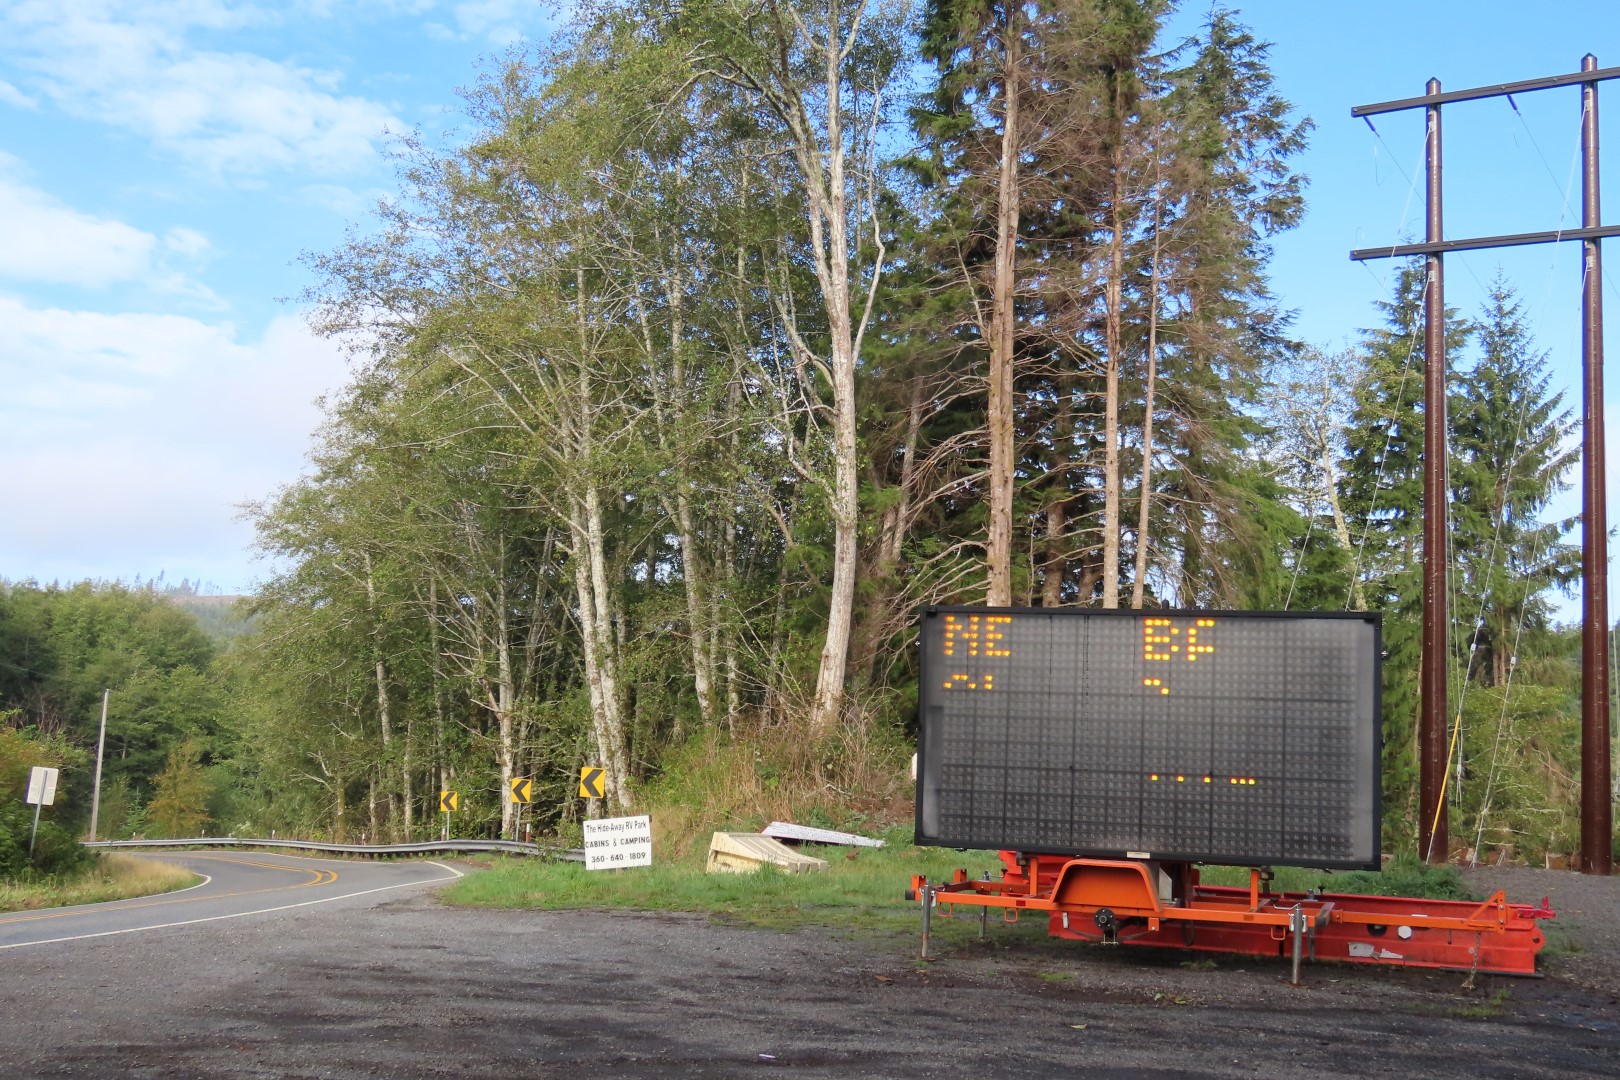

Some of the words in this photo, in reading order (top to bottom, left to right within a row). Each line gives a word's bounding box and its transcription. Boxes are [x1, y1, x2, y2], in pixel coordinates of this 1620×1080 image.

[586, 825, 596, 833] The
[626, 821, 633, 829] RV
[635, 821, 646, 829] Park
[585, 840, 610, 848] CABINS
[613, 838, 617, 846] &
[620, 837, 650, 845] CAMPING
